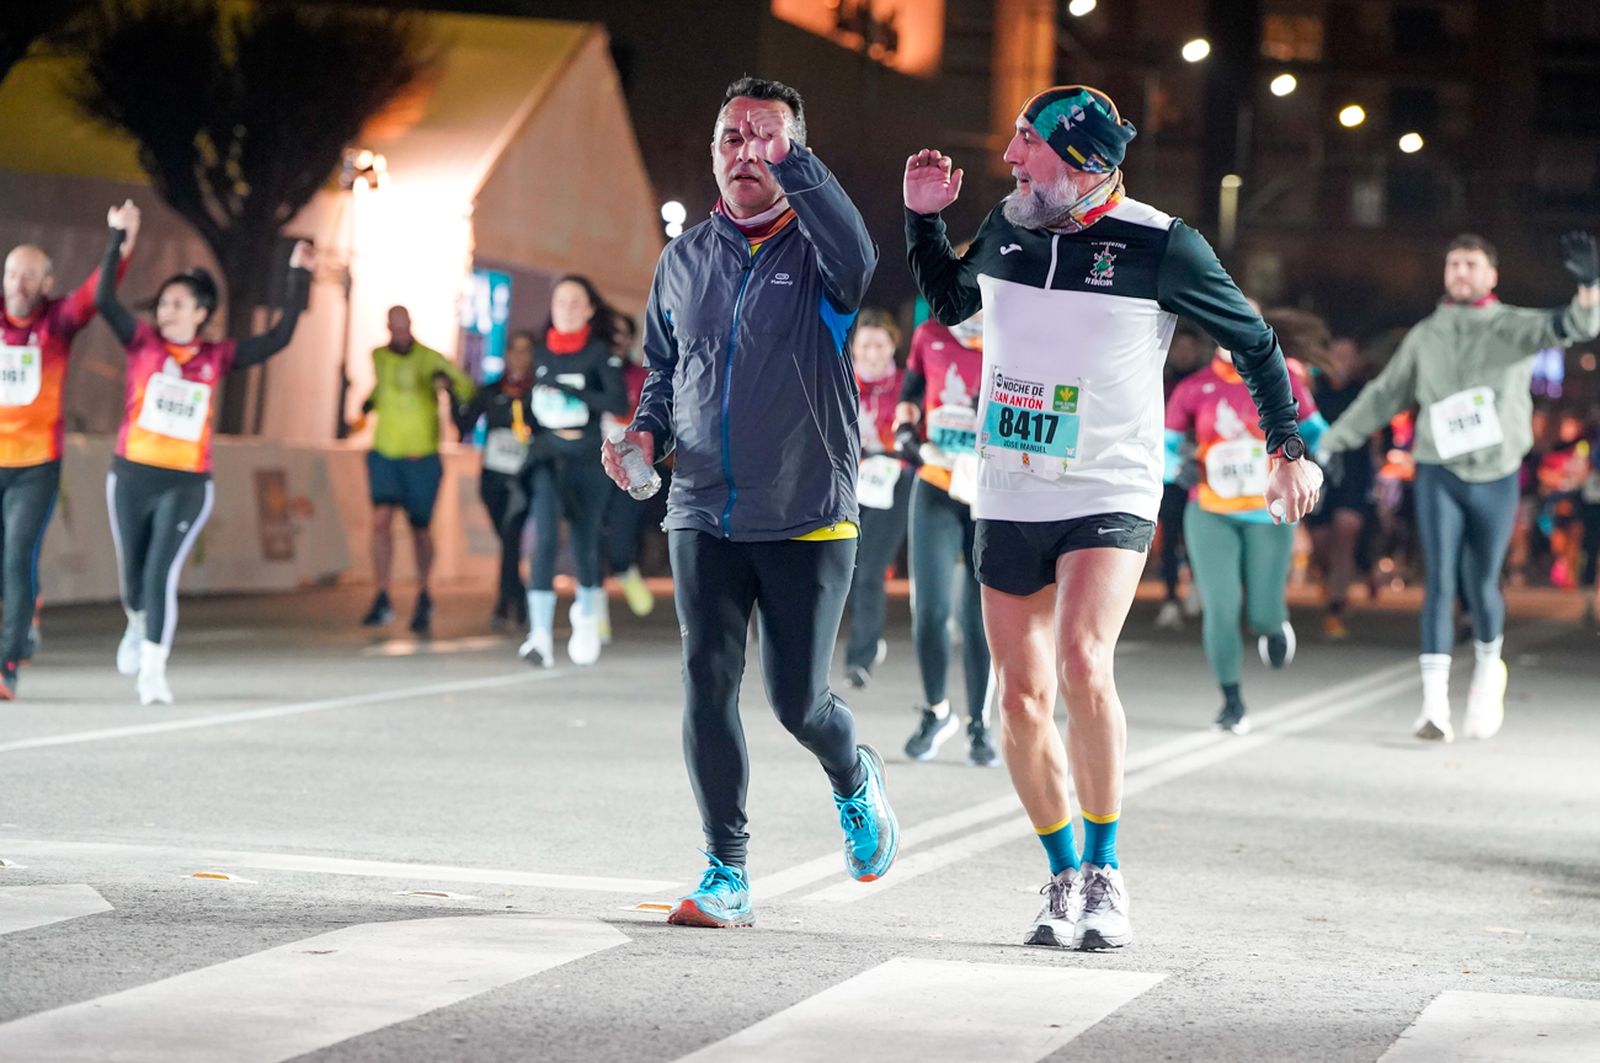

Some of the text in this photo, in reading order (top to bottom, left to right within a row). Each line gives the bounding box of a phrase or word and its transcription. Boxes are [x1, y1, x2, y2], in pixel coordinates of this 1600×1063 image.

[1003, 380, 1030, 395] NOCHE
[1031, 386, 1045, 397] DE
[994, 391, 1009, 404] SAN
[1009, 395, 1043, 410] ANTÓN
[998, 406, 1059, 445] 8417
[1020, 441, 1047, 454] MANUEL
